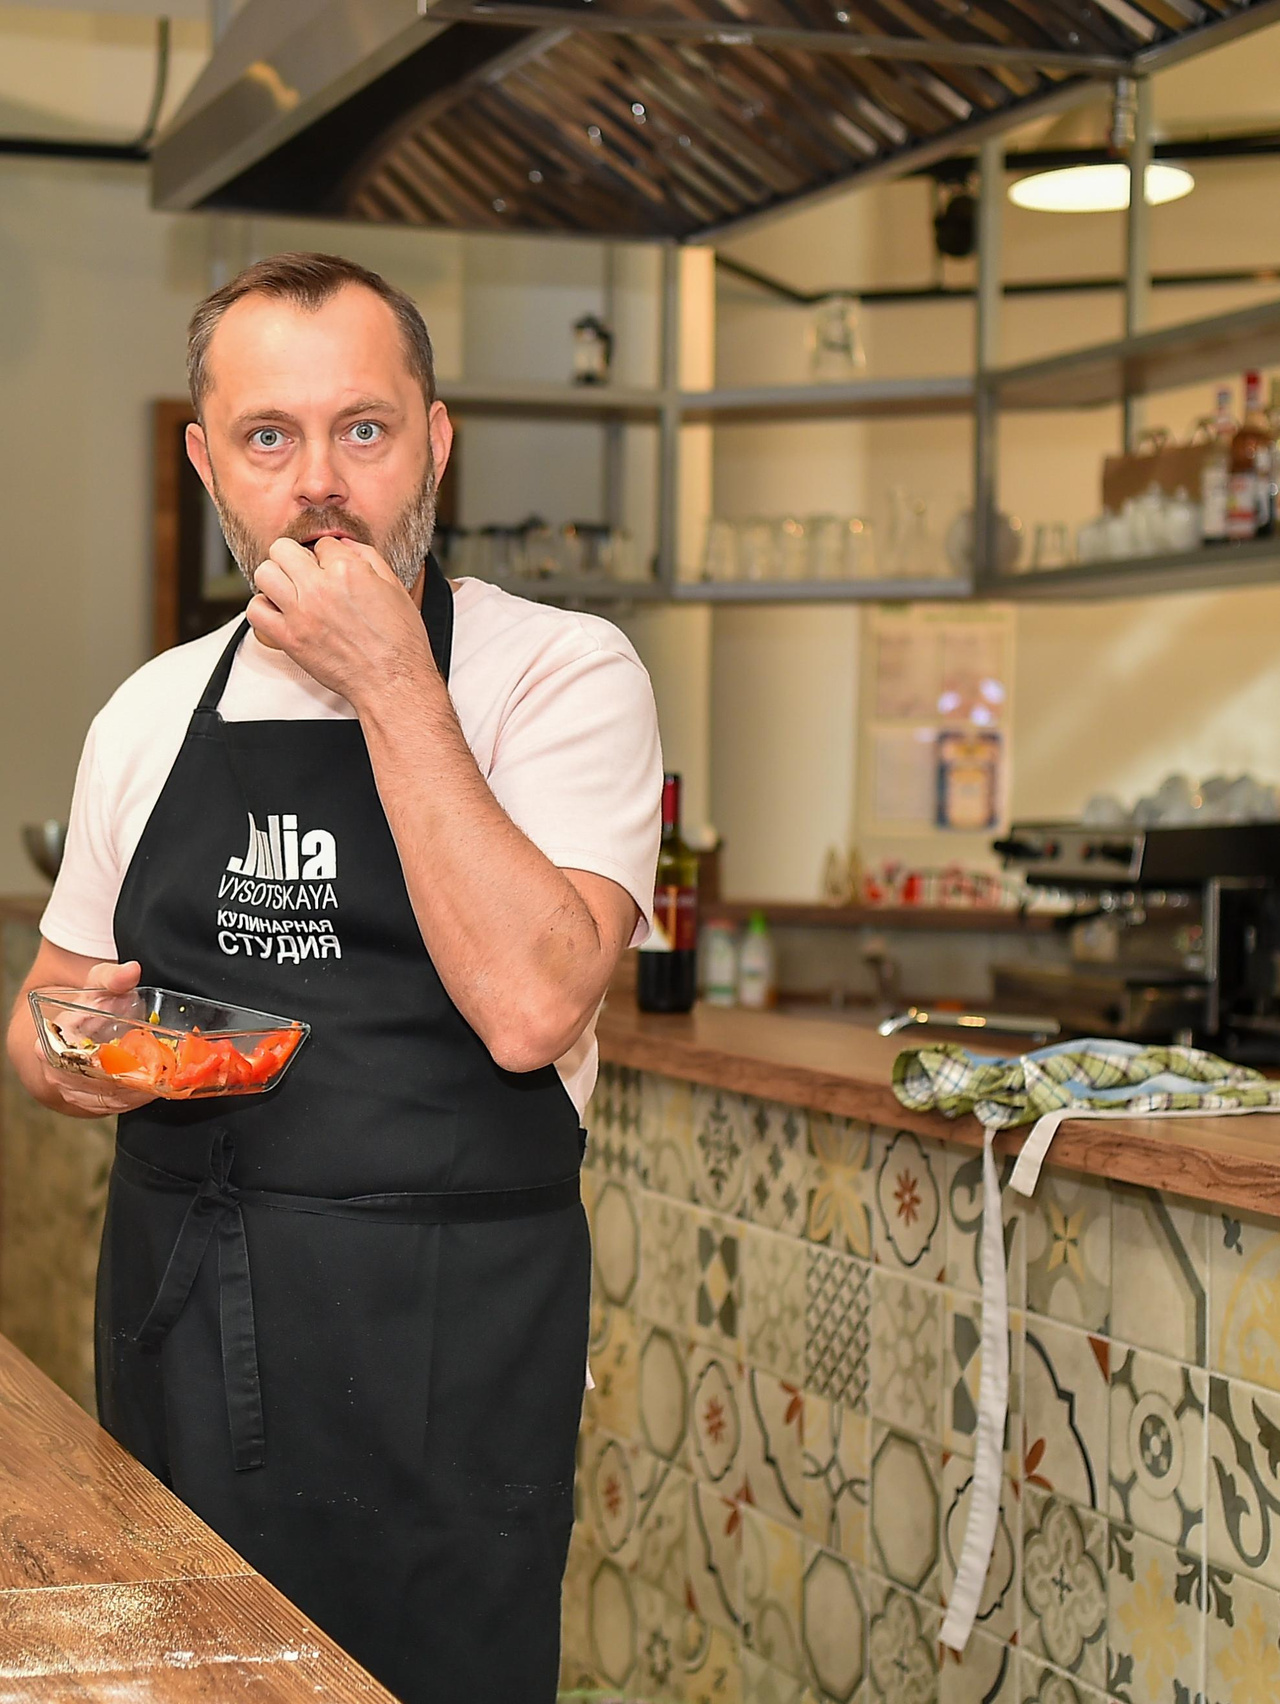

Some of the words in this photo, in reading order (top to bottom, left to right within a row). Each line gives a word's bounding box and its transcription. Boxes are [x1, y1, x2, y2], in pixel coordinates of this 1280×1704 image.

[218, 874, 339, 910] VYSOTSKAYA
[217, 910, 334, 933] КУЛИНАРНАЯ
[218, 931, 342, 964] СТУДИЯ
